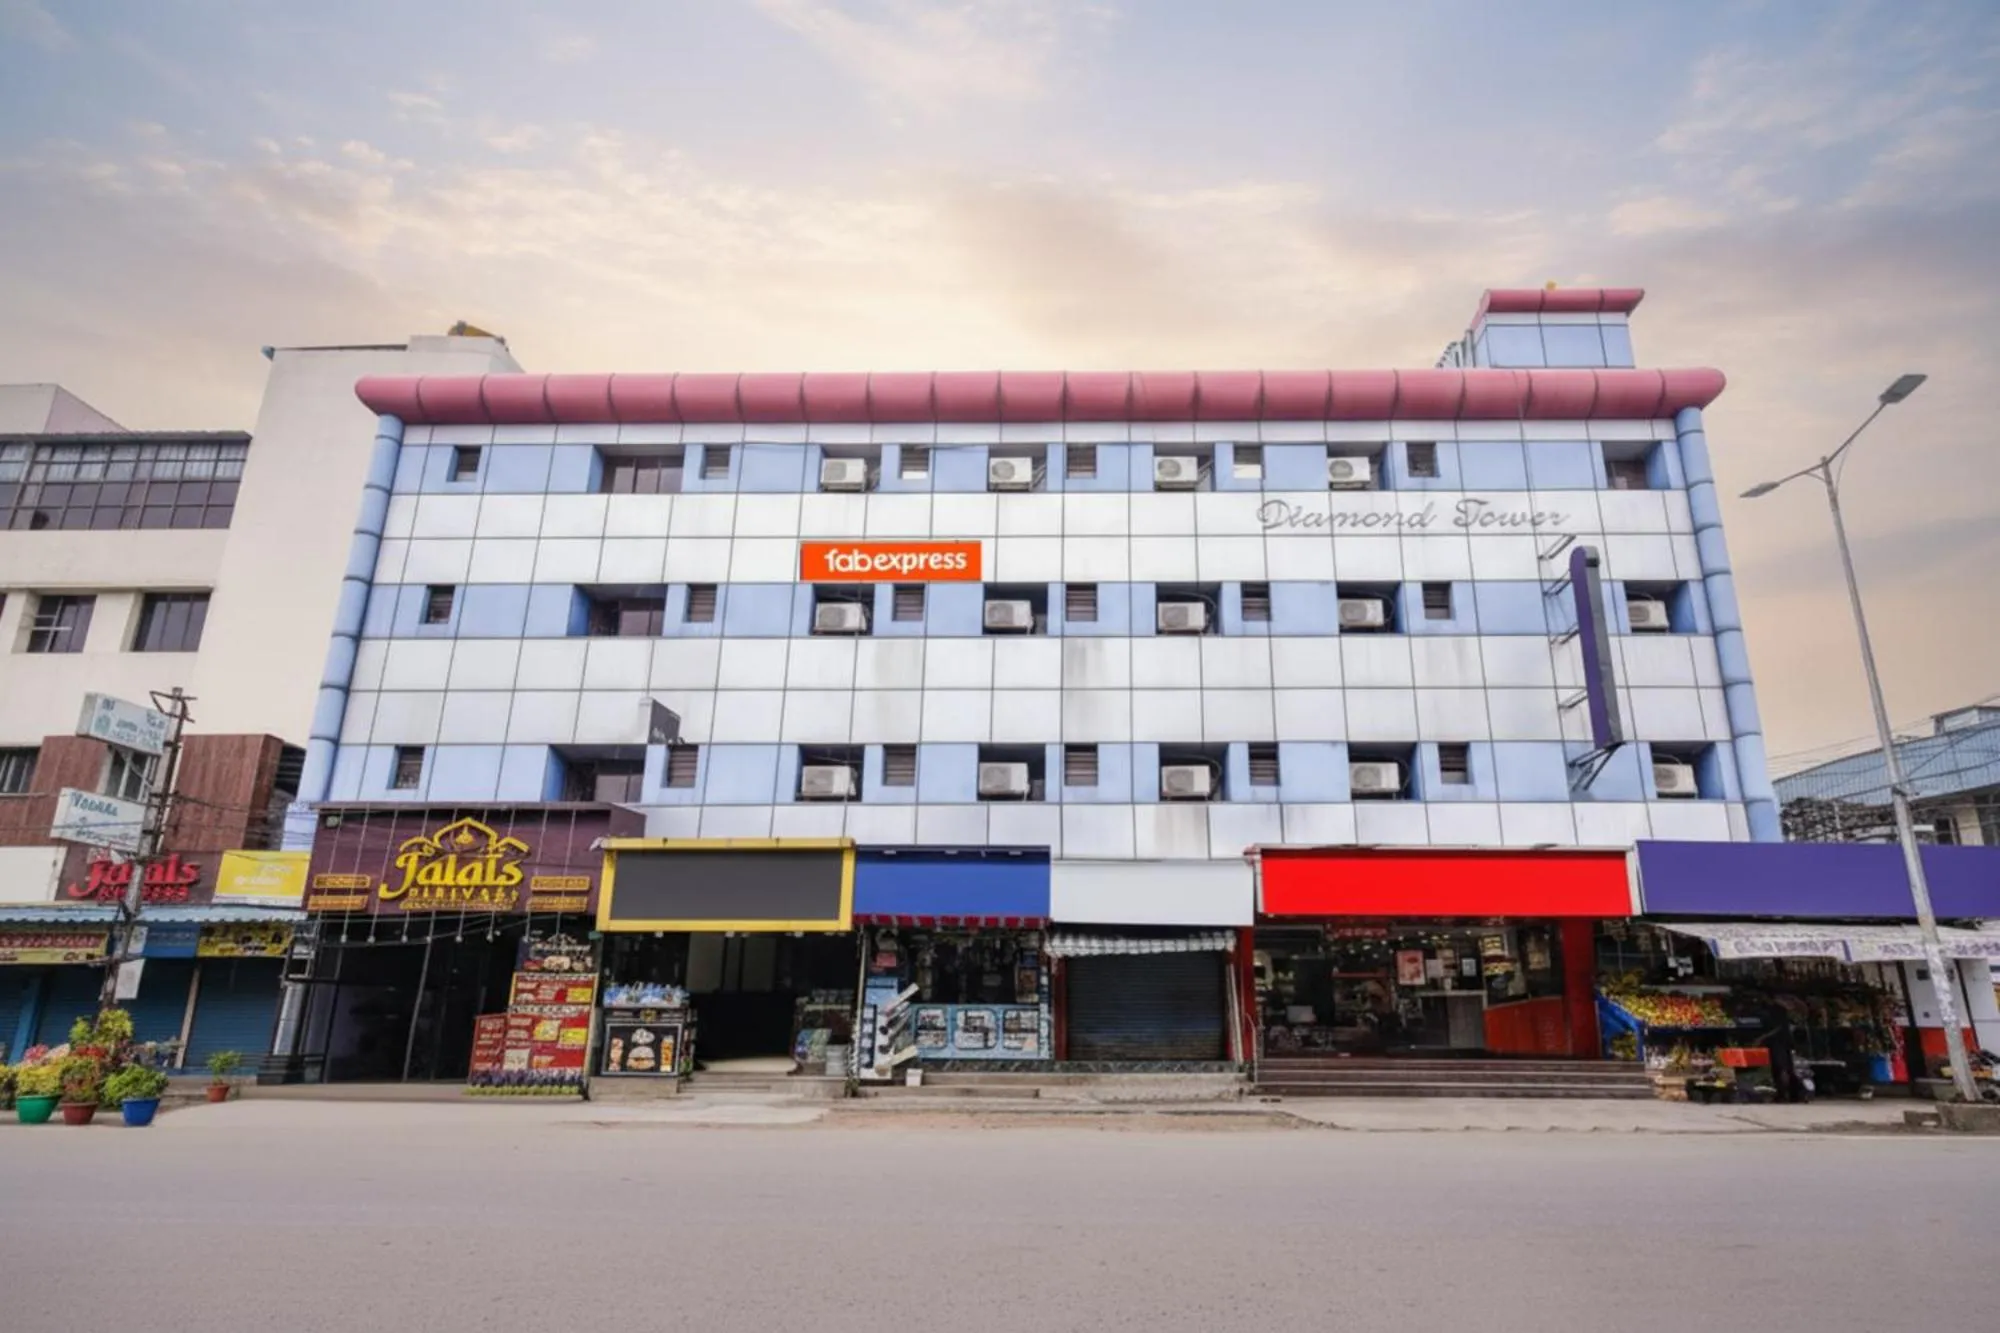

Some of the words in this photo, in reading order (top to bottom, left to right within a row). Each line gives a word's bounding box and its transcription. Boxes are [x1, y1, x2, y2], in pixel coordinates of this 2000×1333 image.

[1257, 499, 1437, 530] Diamond
[1453, 498, 1571, 528] Tower
[824, 548, 968, 575] fabexpress
[68, 853, 203, 897] Jaals
